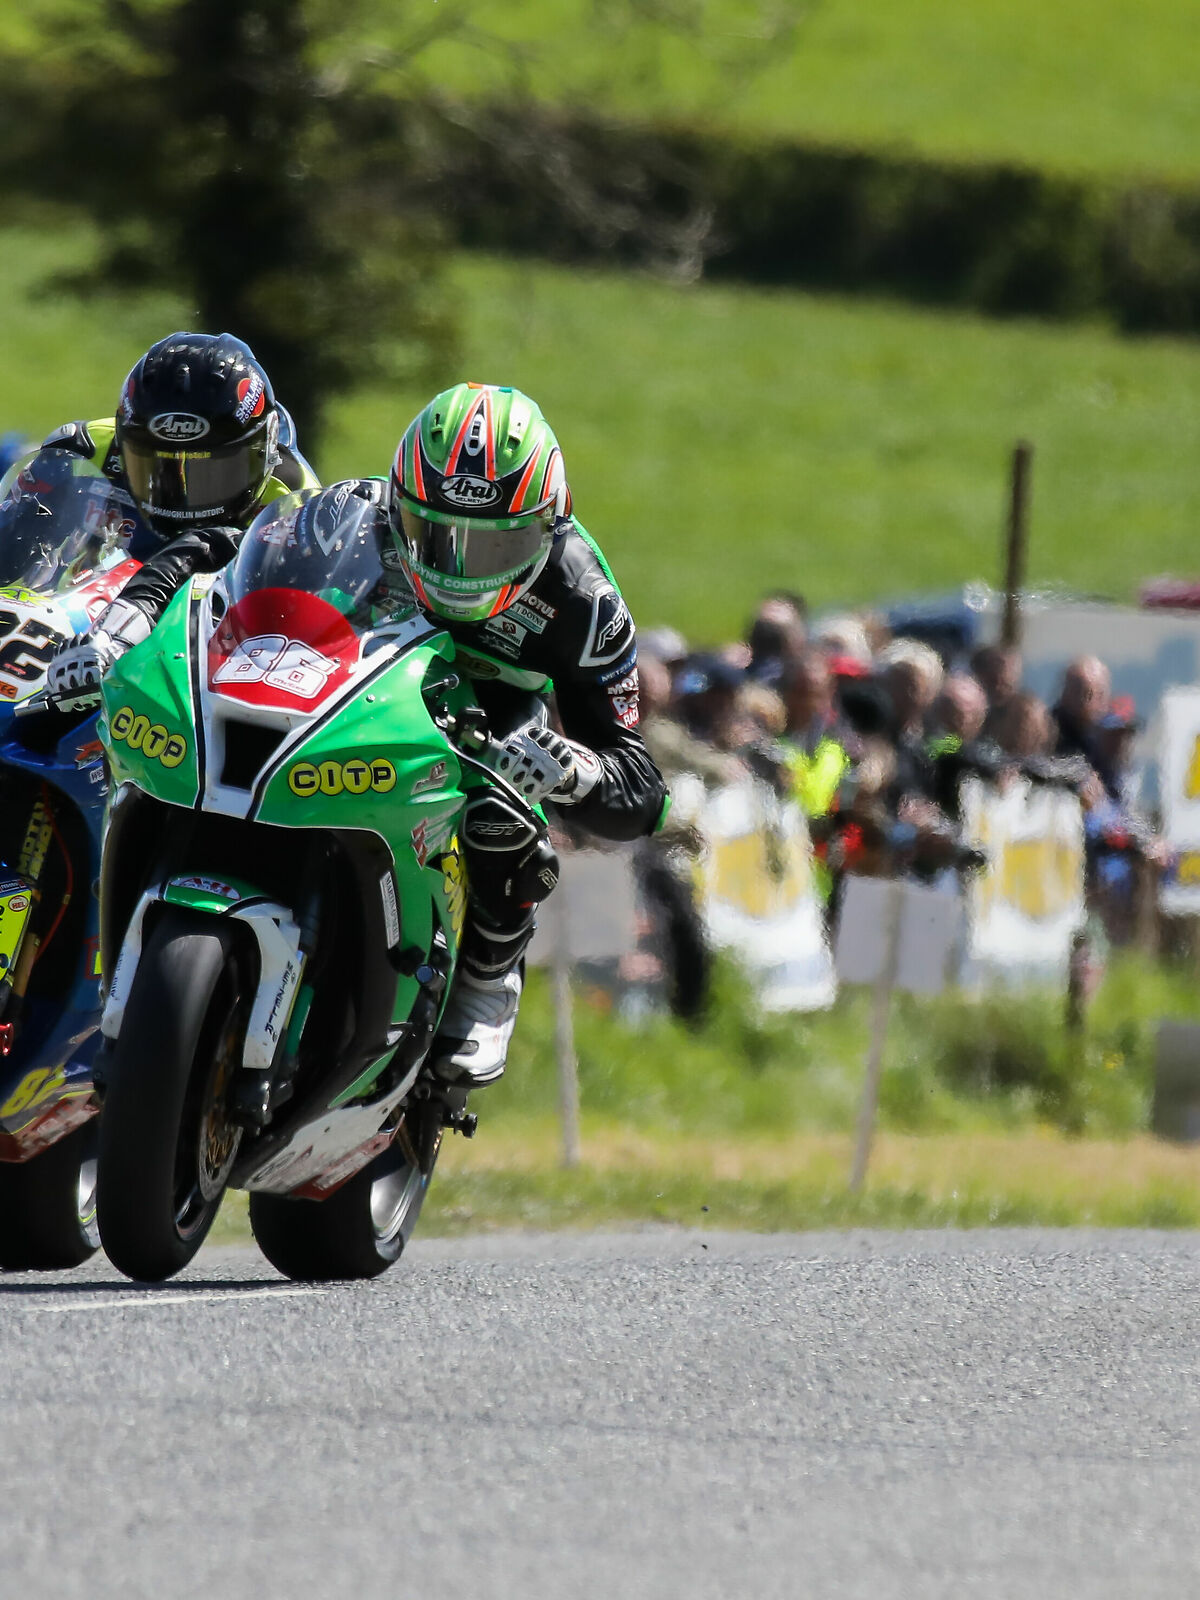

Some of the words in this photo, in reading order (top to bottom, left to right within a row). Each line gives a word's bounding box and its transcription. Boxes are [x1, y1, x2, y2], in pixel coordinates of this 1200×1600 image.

[157, 414, 203, 434] Arai
[443, 478, 497, 500] Arai
[194, 506, 225, 519] MOTORS
[444, 562, 532, 590] CONSTRUCTION
[114, 713, 183, 758] CITP
[293, 762, 393, 788] CITP
[468, 821, 526, 836] RST
